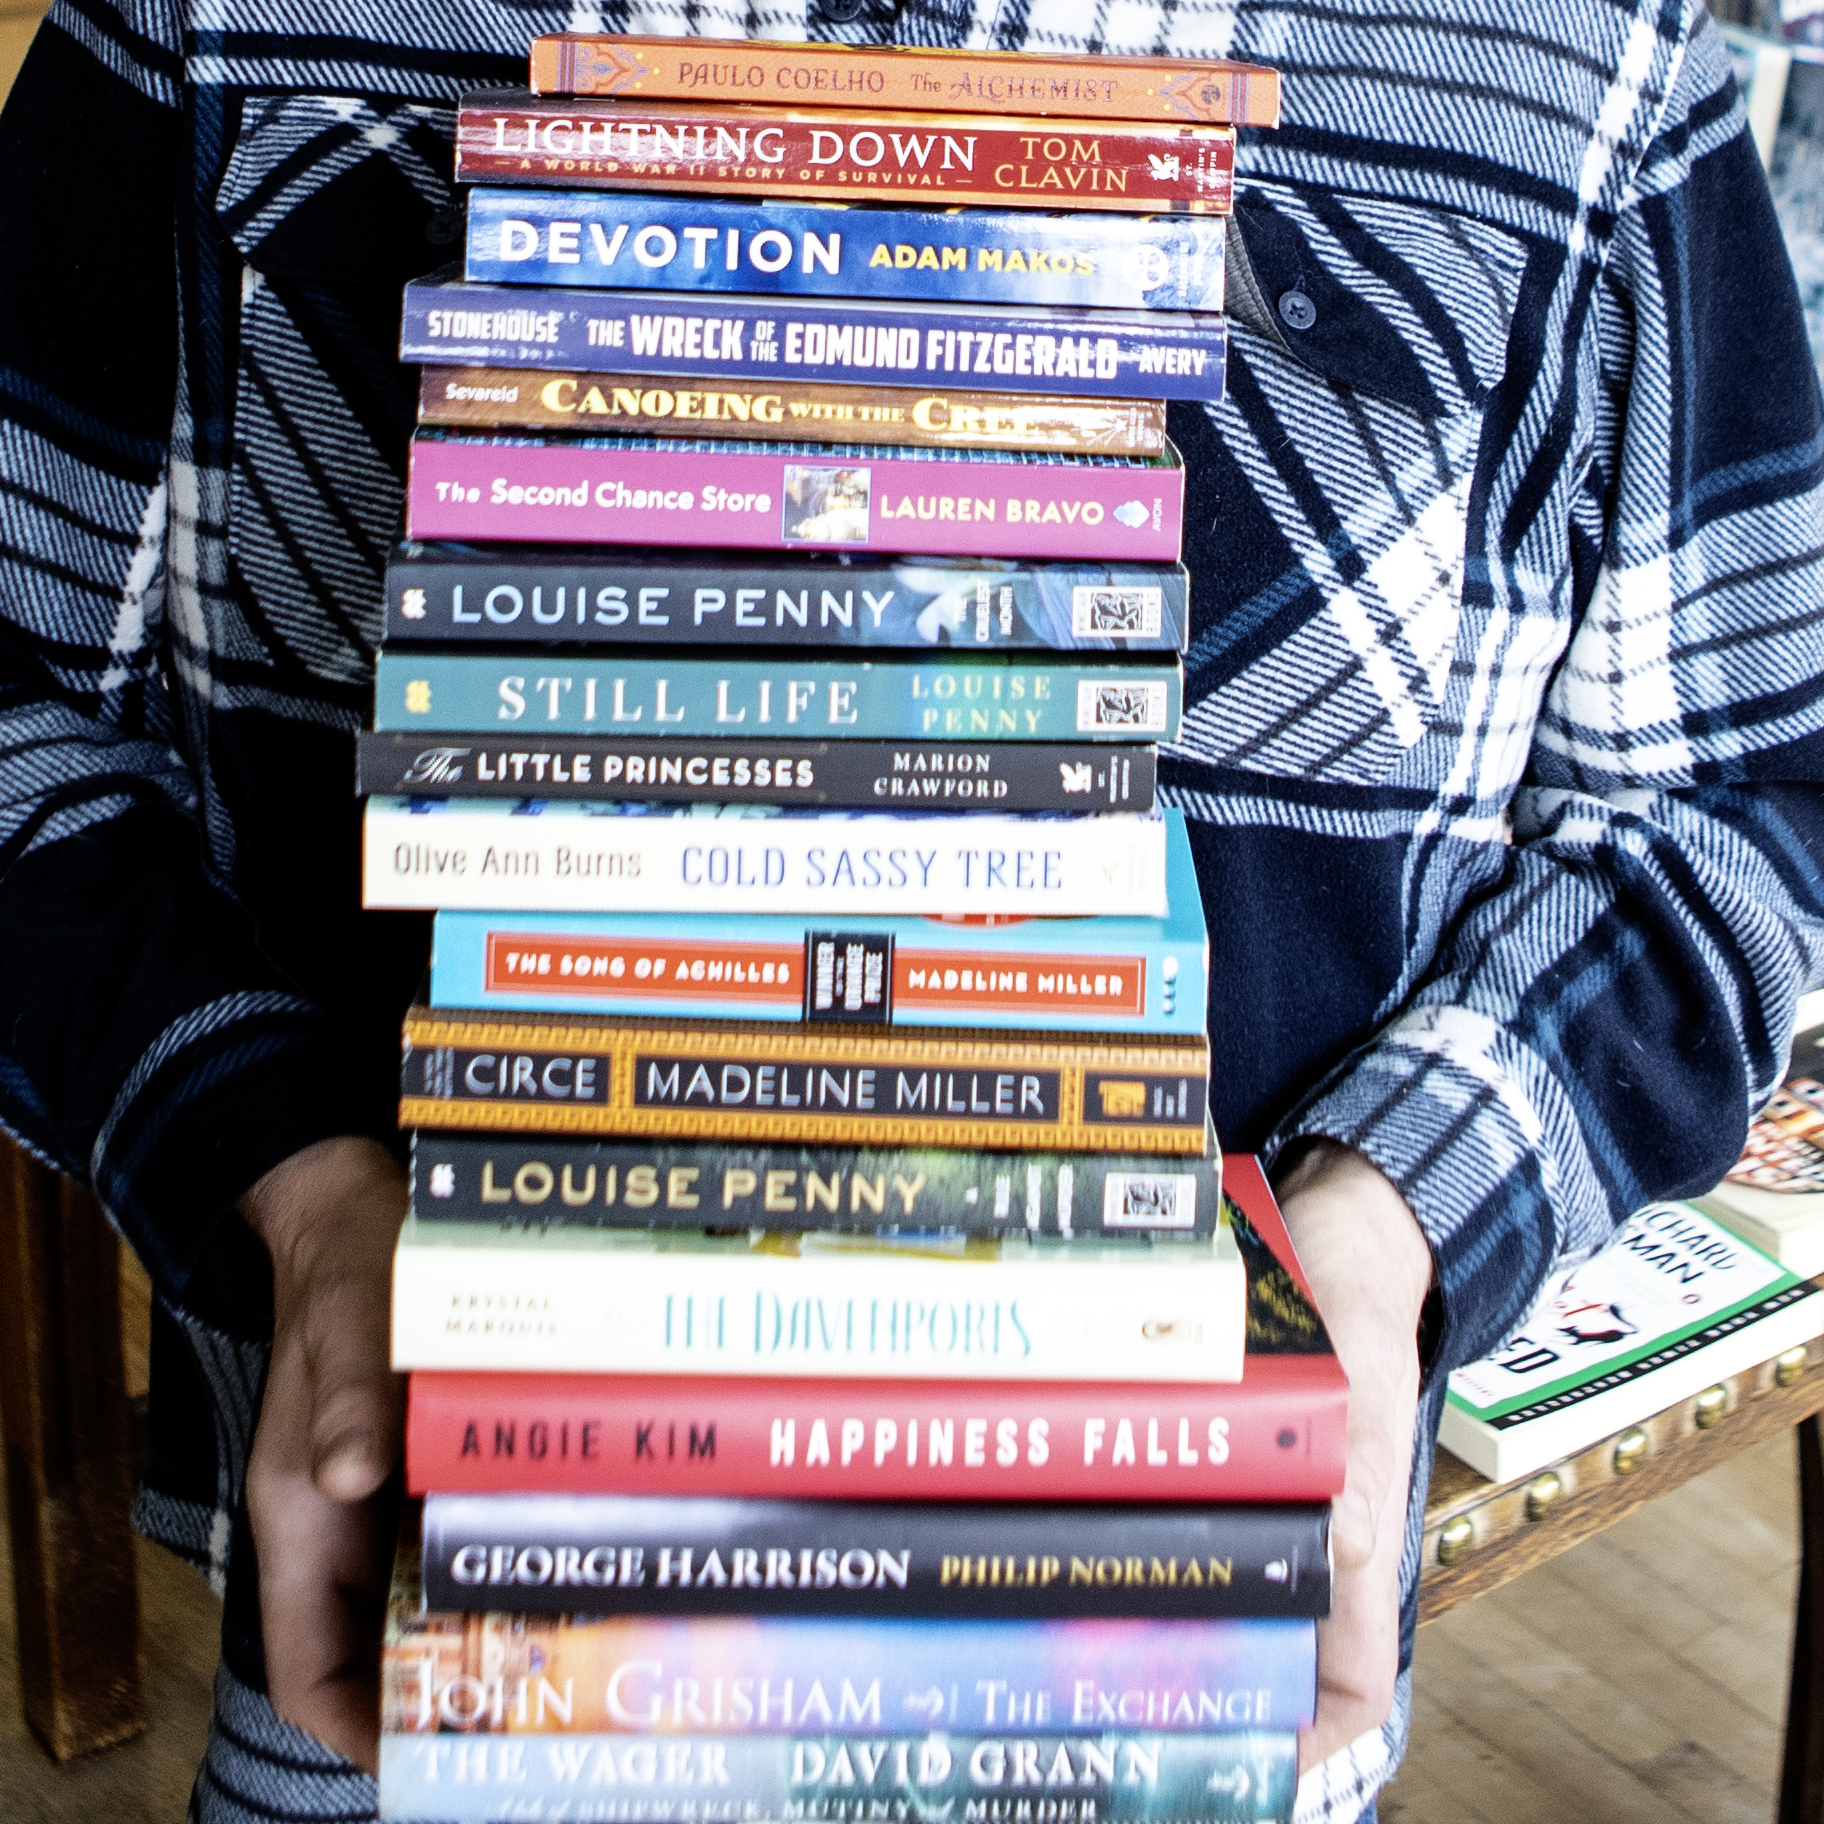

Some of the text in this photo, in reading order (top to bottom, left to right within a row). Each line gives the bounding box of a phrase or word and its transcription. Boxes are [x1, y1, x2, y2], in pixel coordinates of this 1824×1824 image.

[678, 61, 1118, 104] PAULO COELHO The ALCHEMIST
[492, 118, 978, 173] LIGHTNING DOWN
[1019, 136, 1103, 163] TOM
[520, 159, 946, 186] A WORLD WAR II STORY OF SURVIVAL
[994, 164, 1129, 193] CLAVIN
[498, 219, 1095, 276] DEVOTION ADAM MAKOS
[427, 310, 1207, 380] STONEHOUSE THE WRECK OF THE EDMUND FITZGERALD AVERY
[445, 382, 519, 403] Sevareid
[540, 378, 785, 424] CANOEING
[789, 402, 858, 422] WITH
[860, 405, 905, 424] THE
[436, 478, 772, 513] The Second Chance Store
[879, 494, 1105, 527] LAUREN BRAVO
[1151, 497, 1163, 532] AVON
[452, 584, 895, 629] LOUISE PENNY
[497, 676, 858, 725] STILL LIFE
[912, 674, 1052, 700] LOUISE
[922, 707, 1043, 734] PENNY
[404, 747, 815, 788] The LITTLE PRINCESSES
[893, 752, 991, 773] MARION
[873, 776, 1008, 799] CRAWFORD
[393, 842, 1062, 889] Olive Ann Burns COLD SASSY TREE
[506, 952, 790, 985] THE SONG OF ACHILLES
[908, 968, 1123, 997] MADELINE MILLER
[464, 1054, 597, 1100] CIRCE
[647, 1061, 876, 1110] MADELINE
[896, 1070, 1045, 1116] MILLER
[481, 1160, 701, 1210] LOUISE
[722, 1166, 926, 1215] PENNY
[1622, 1231, 1704, 1284] MAN
[1635, 1209, 1738, 1270] ICHARD
[460, 1416, 1230, 1468] ANGIE KIM HAPPINESS FALLS
[451, 1544, 1233, 1589] GEORGE HARRISON PHILIP NORMAN
[417, 1654, 1272, 1731] JOHN GRISHAM THE EXCHANGE
[415, 1739, 1162, 1787] THE WAGER DAVID GRANN
[783, 1798, 910, 1821] MUTINY
[966, 1798, 1097, 1822] MURDER
